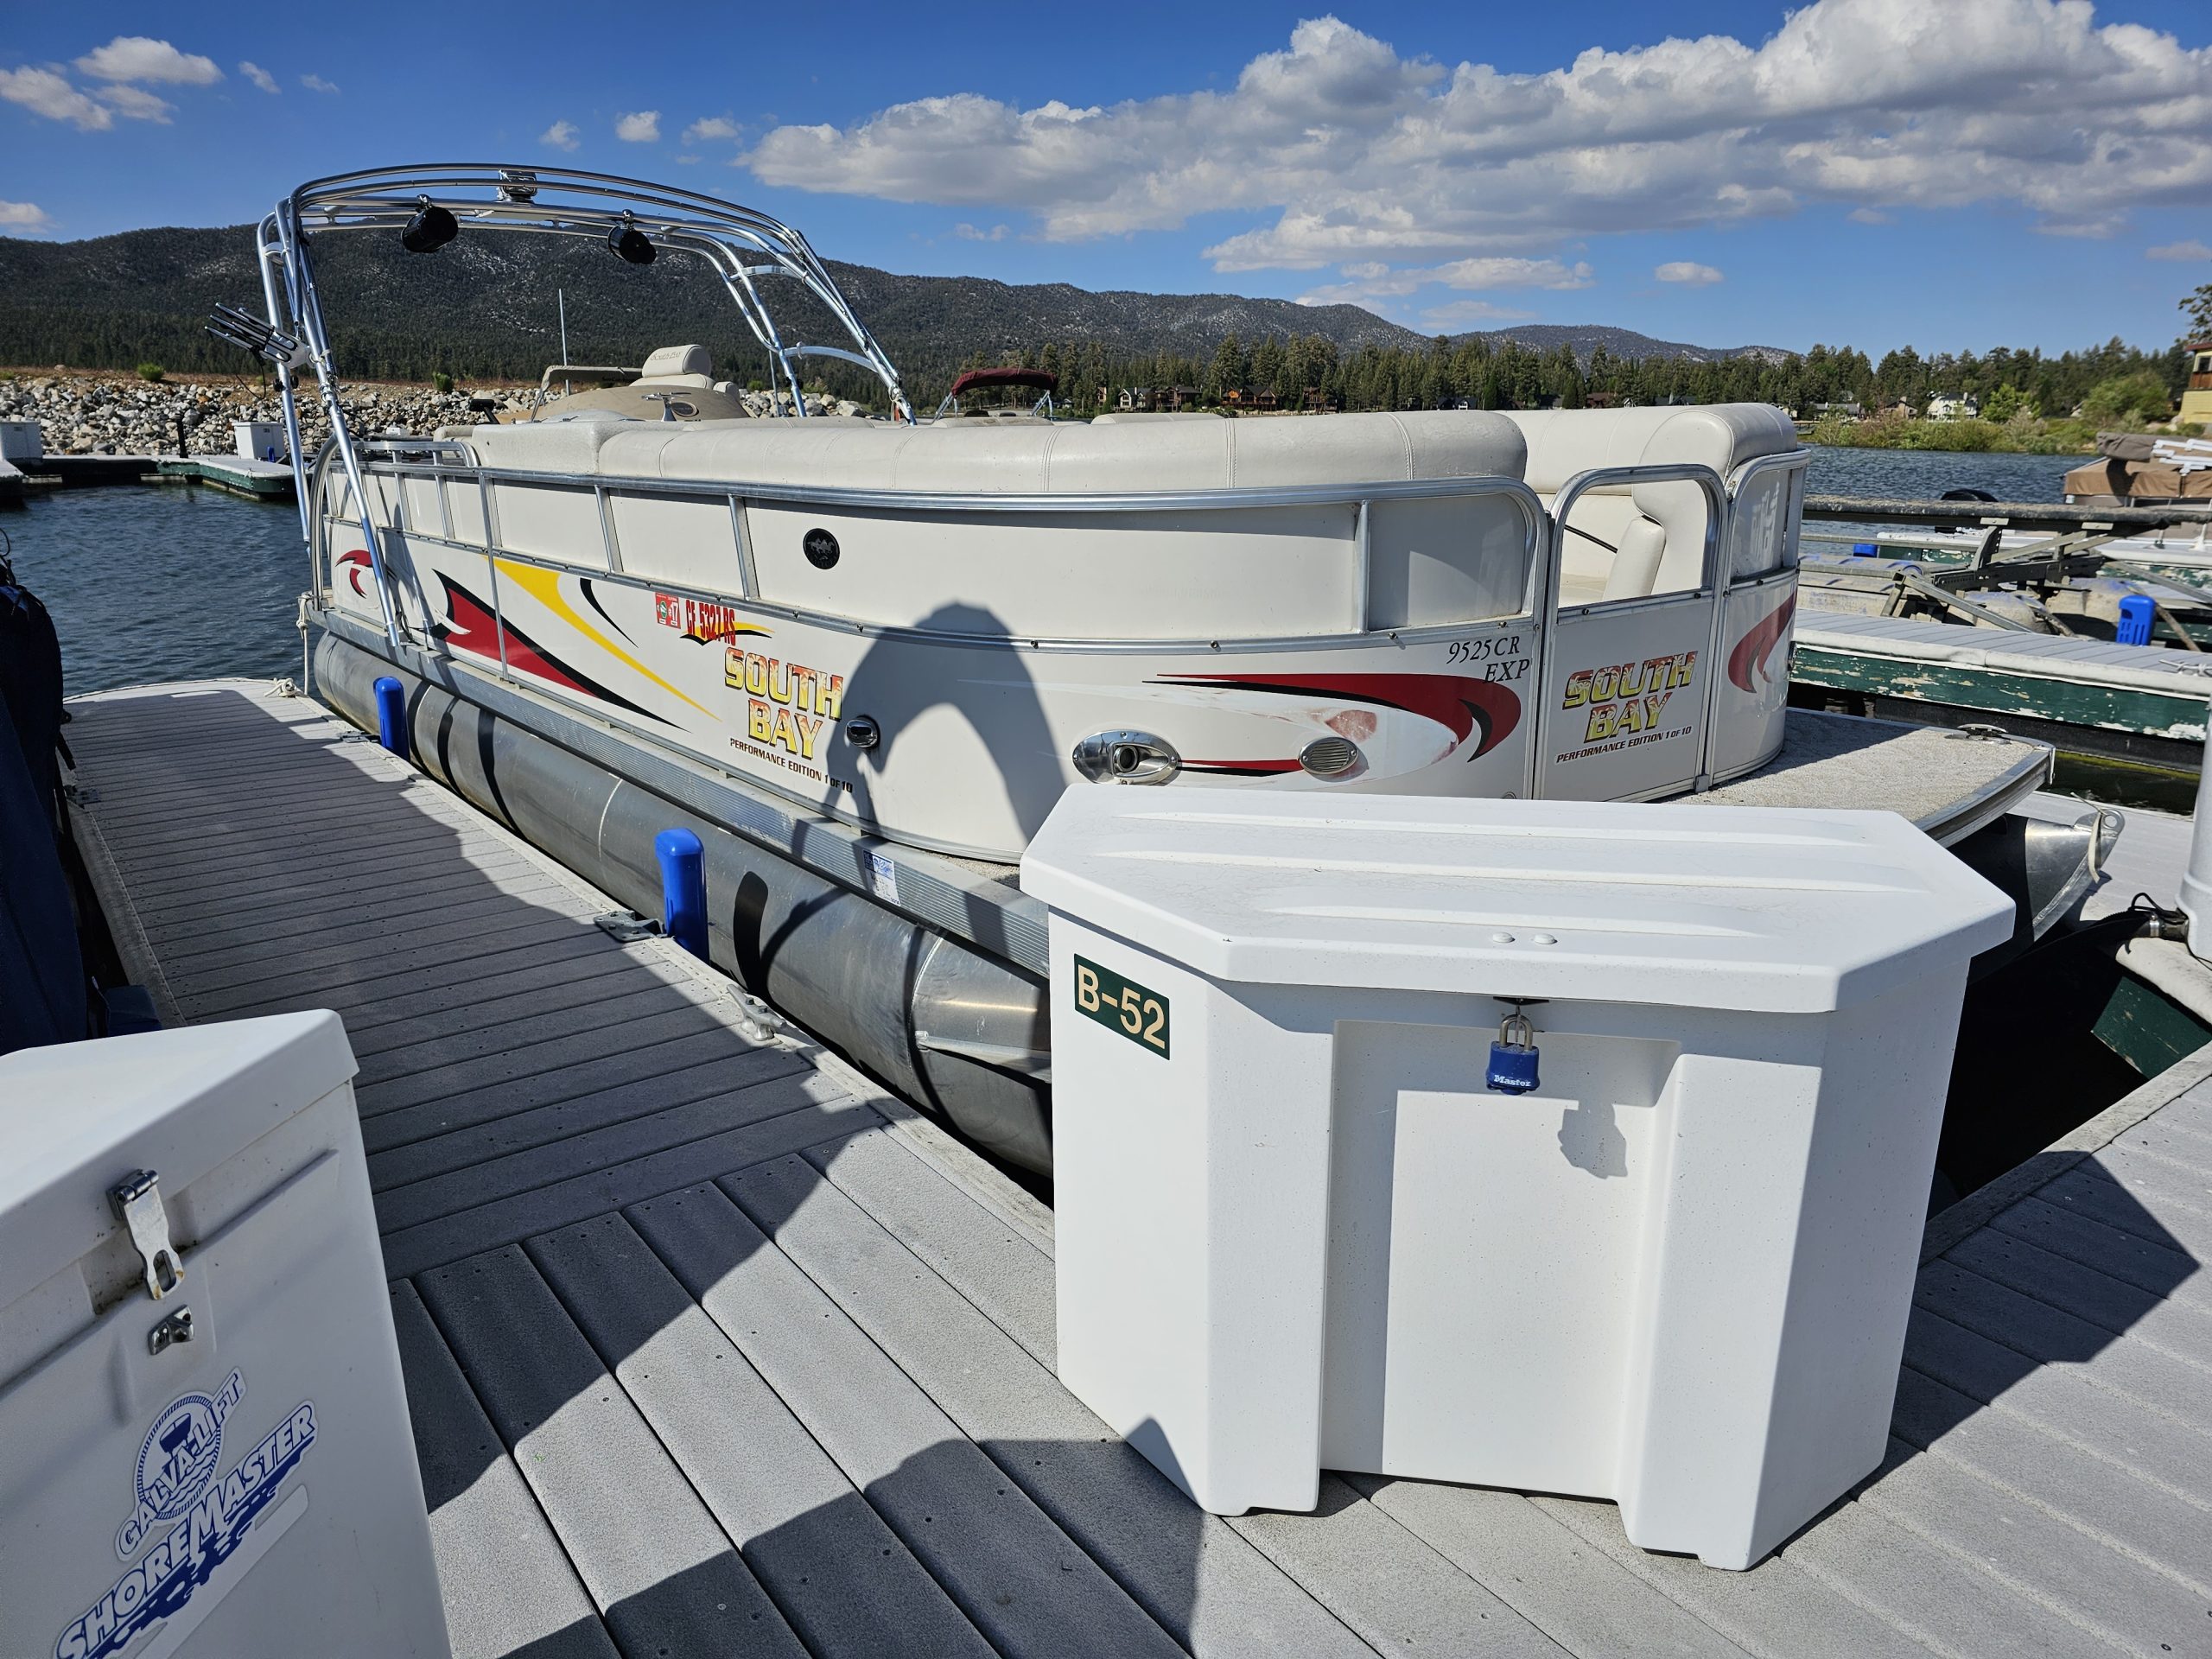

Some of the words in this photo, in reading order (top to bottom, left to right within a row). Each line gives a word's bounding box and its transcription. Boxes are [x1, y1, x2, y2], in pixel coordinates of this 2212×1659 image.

[686, 599, 696, 636] CF
[699, 602, 721, 641] 5327
[723, 607, 736, 646] RS
[1446, 635, 1520, 664] 9525CR
[725, 647, 843, 721] SOUTH
[1483, 658, 1530, 683] EXP
[1562, 651, 1698, 710] SOUTH
[748, 698, 823, 760] BAY
[1556, 741, 1625, 763] PERFORMANCE
[1628, 732, 1663, 747] EDITION
[1681, 726, 1692, 735] 10
[1584, 692, 1673, 743] BAY
[730, 738, 785, 767] PERFORMANCE
[788, 760, 822, 781] EDITION
[830, 778, 841, 789] OF
[842, 781, 853, 793] 10
[1078, 964, 1165, 1049] B-52
[1494, 1075, 1531, 1087] Master
[119, 1372, 240, 1555] GALVA-LIFT
[56, 1404, 315, 1659] SHOREMASTER
